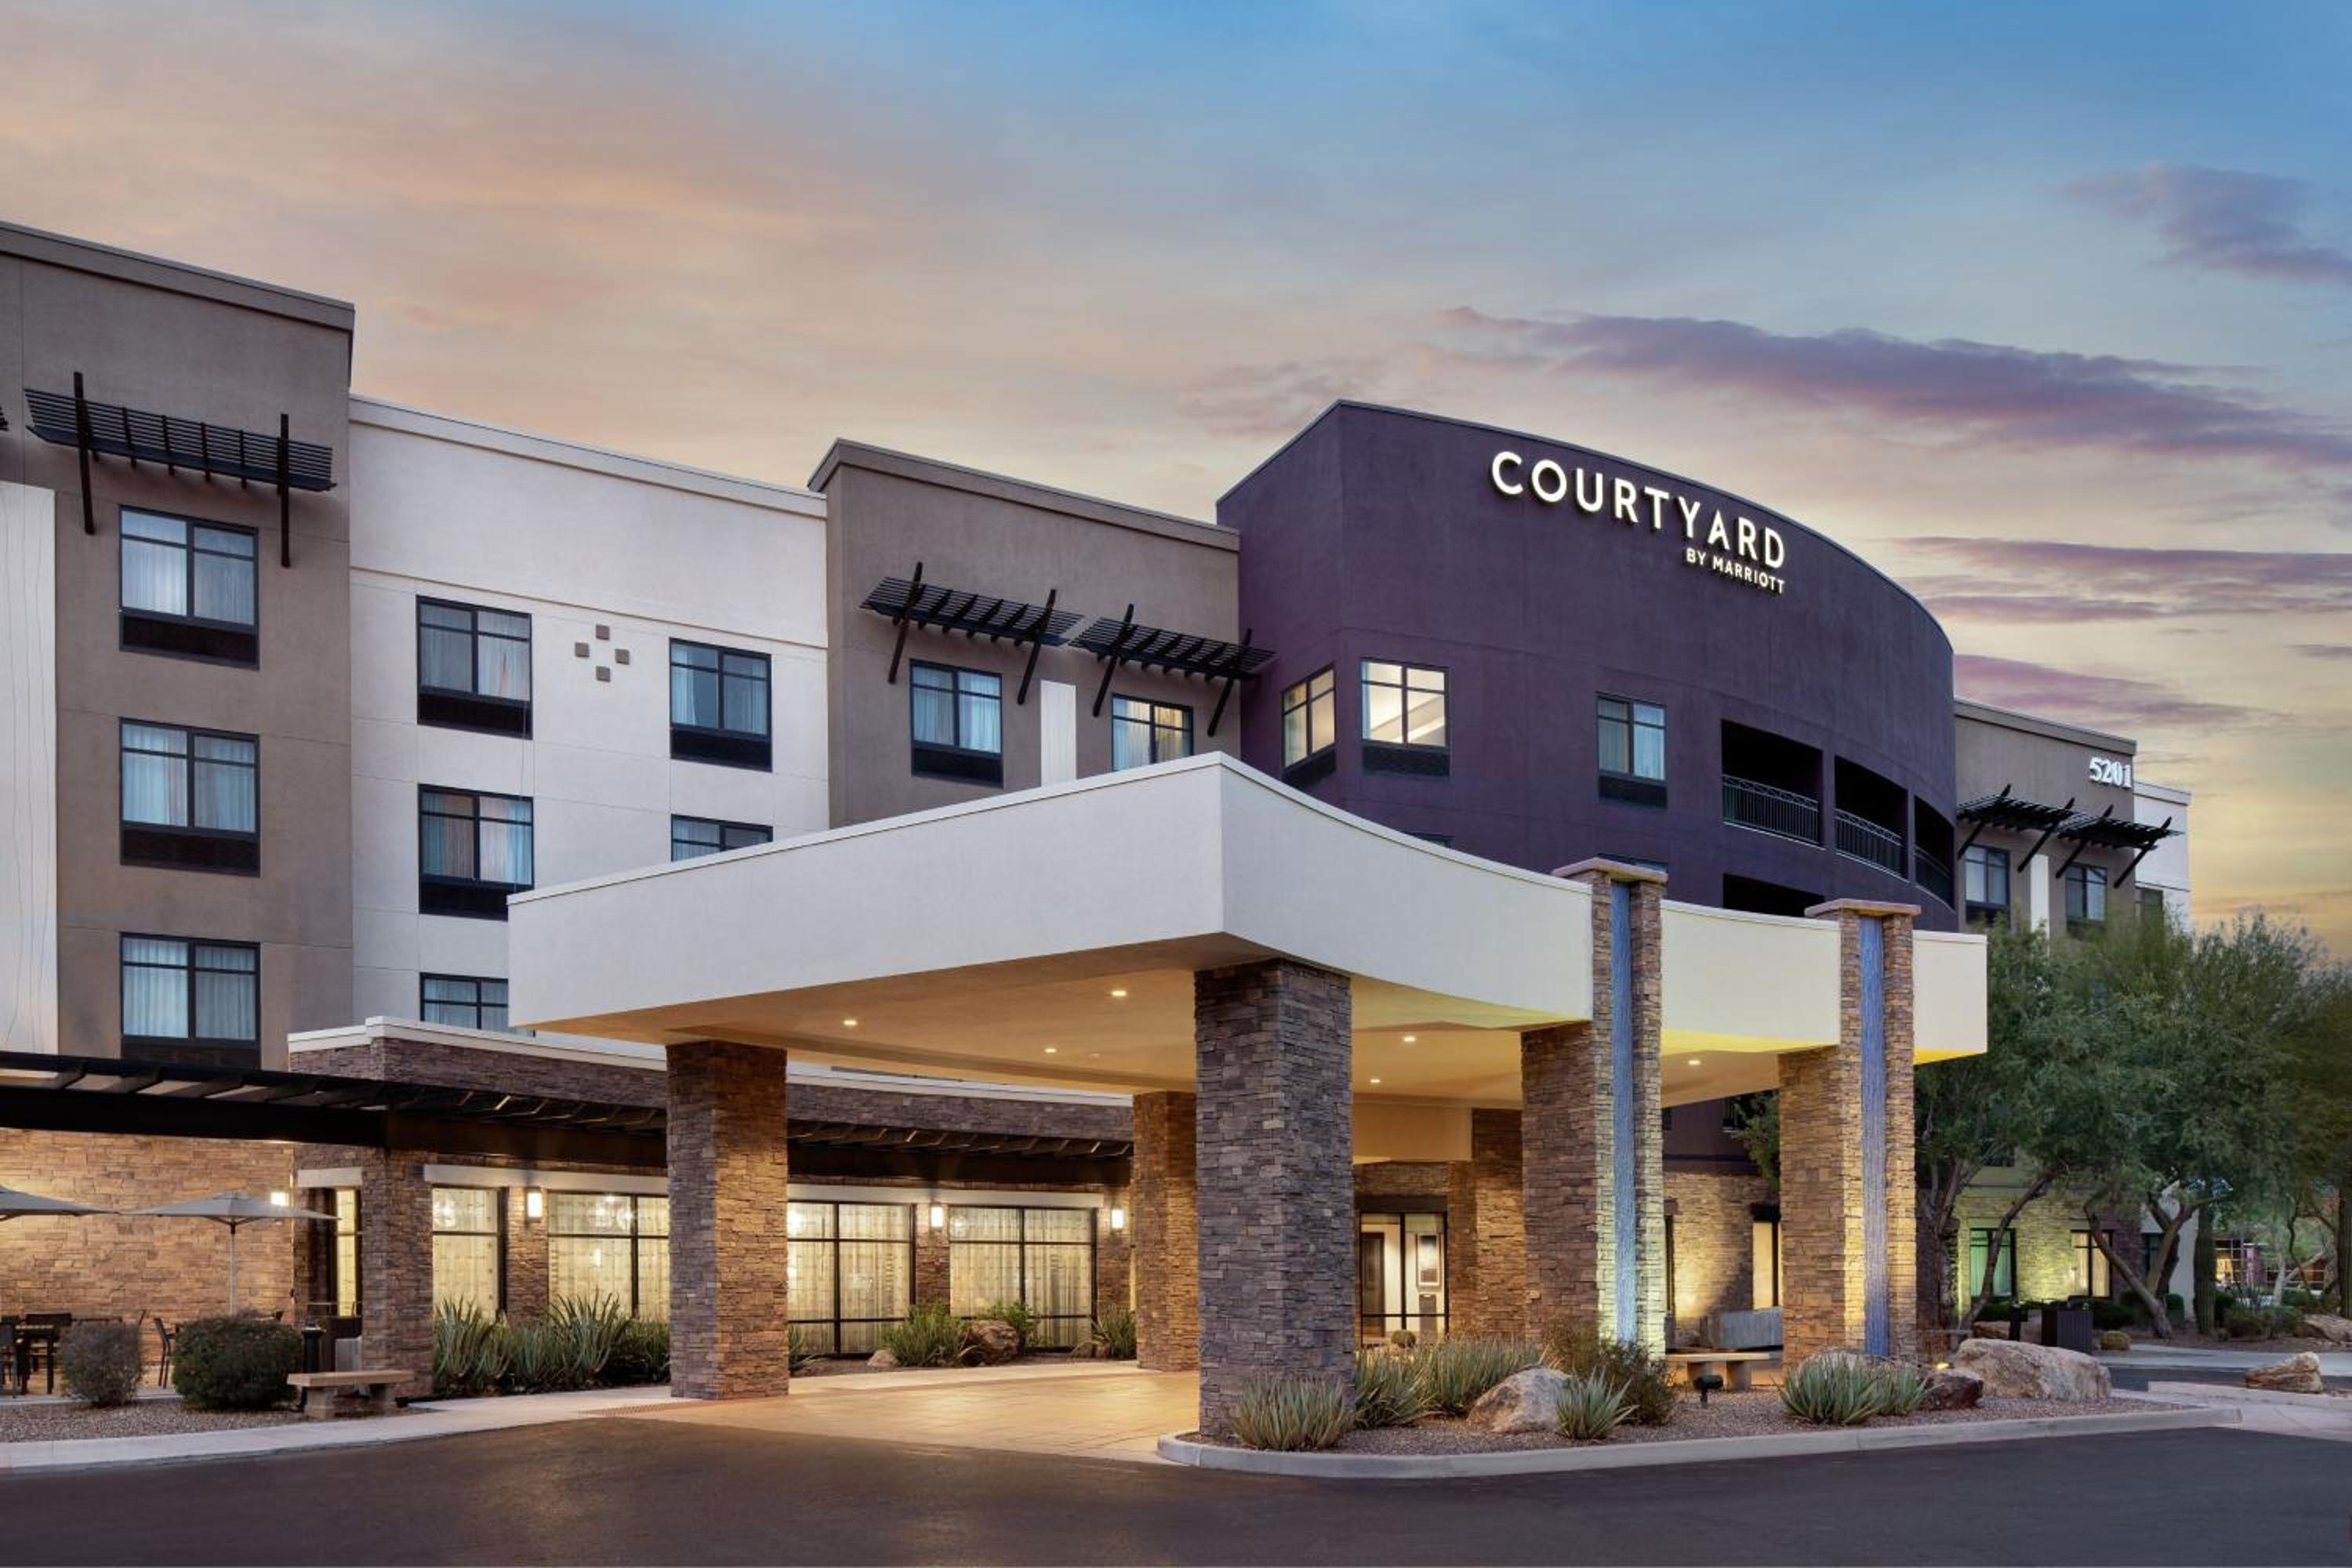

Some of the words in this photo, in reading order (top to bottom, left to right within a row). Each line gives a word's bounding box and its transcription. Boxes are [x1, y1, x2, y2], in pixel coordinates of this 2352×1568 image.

[1491, 451, 1785, 569] COURTYARD
[1686, 548, 1706, 565] BY
[1713, 556, 1785, 594] MARRIOTT
[2089, 757, 2132, 789] 5201
